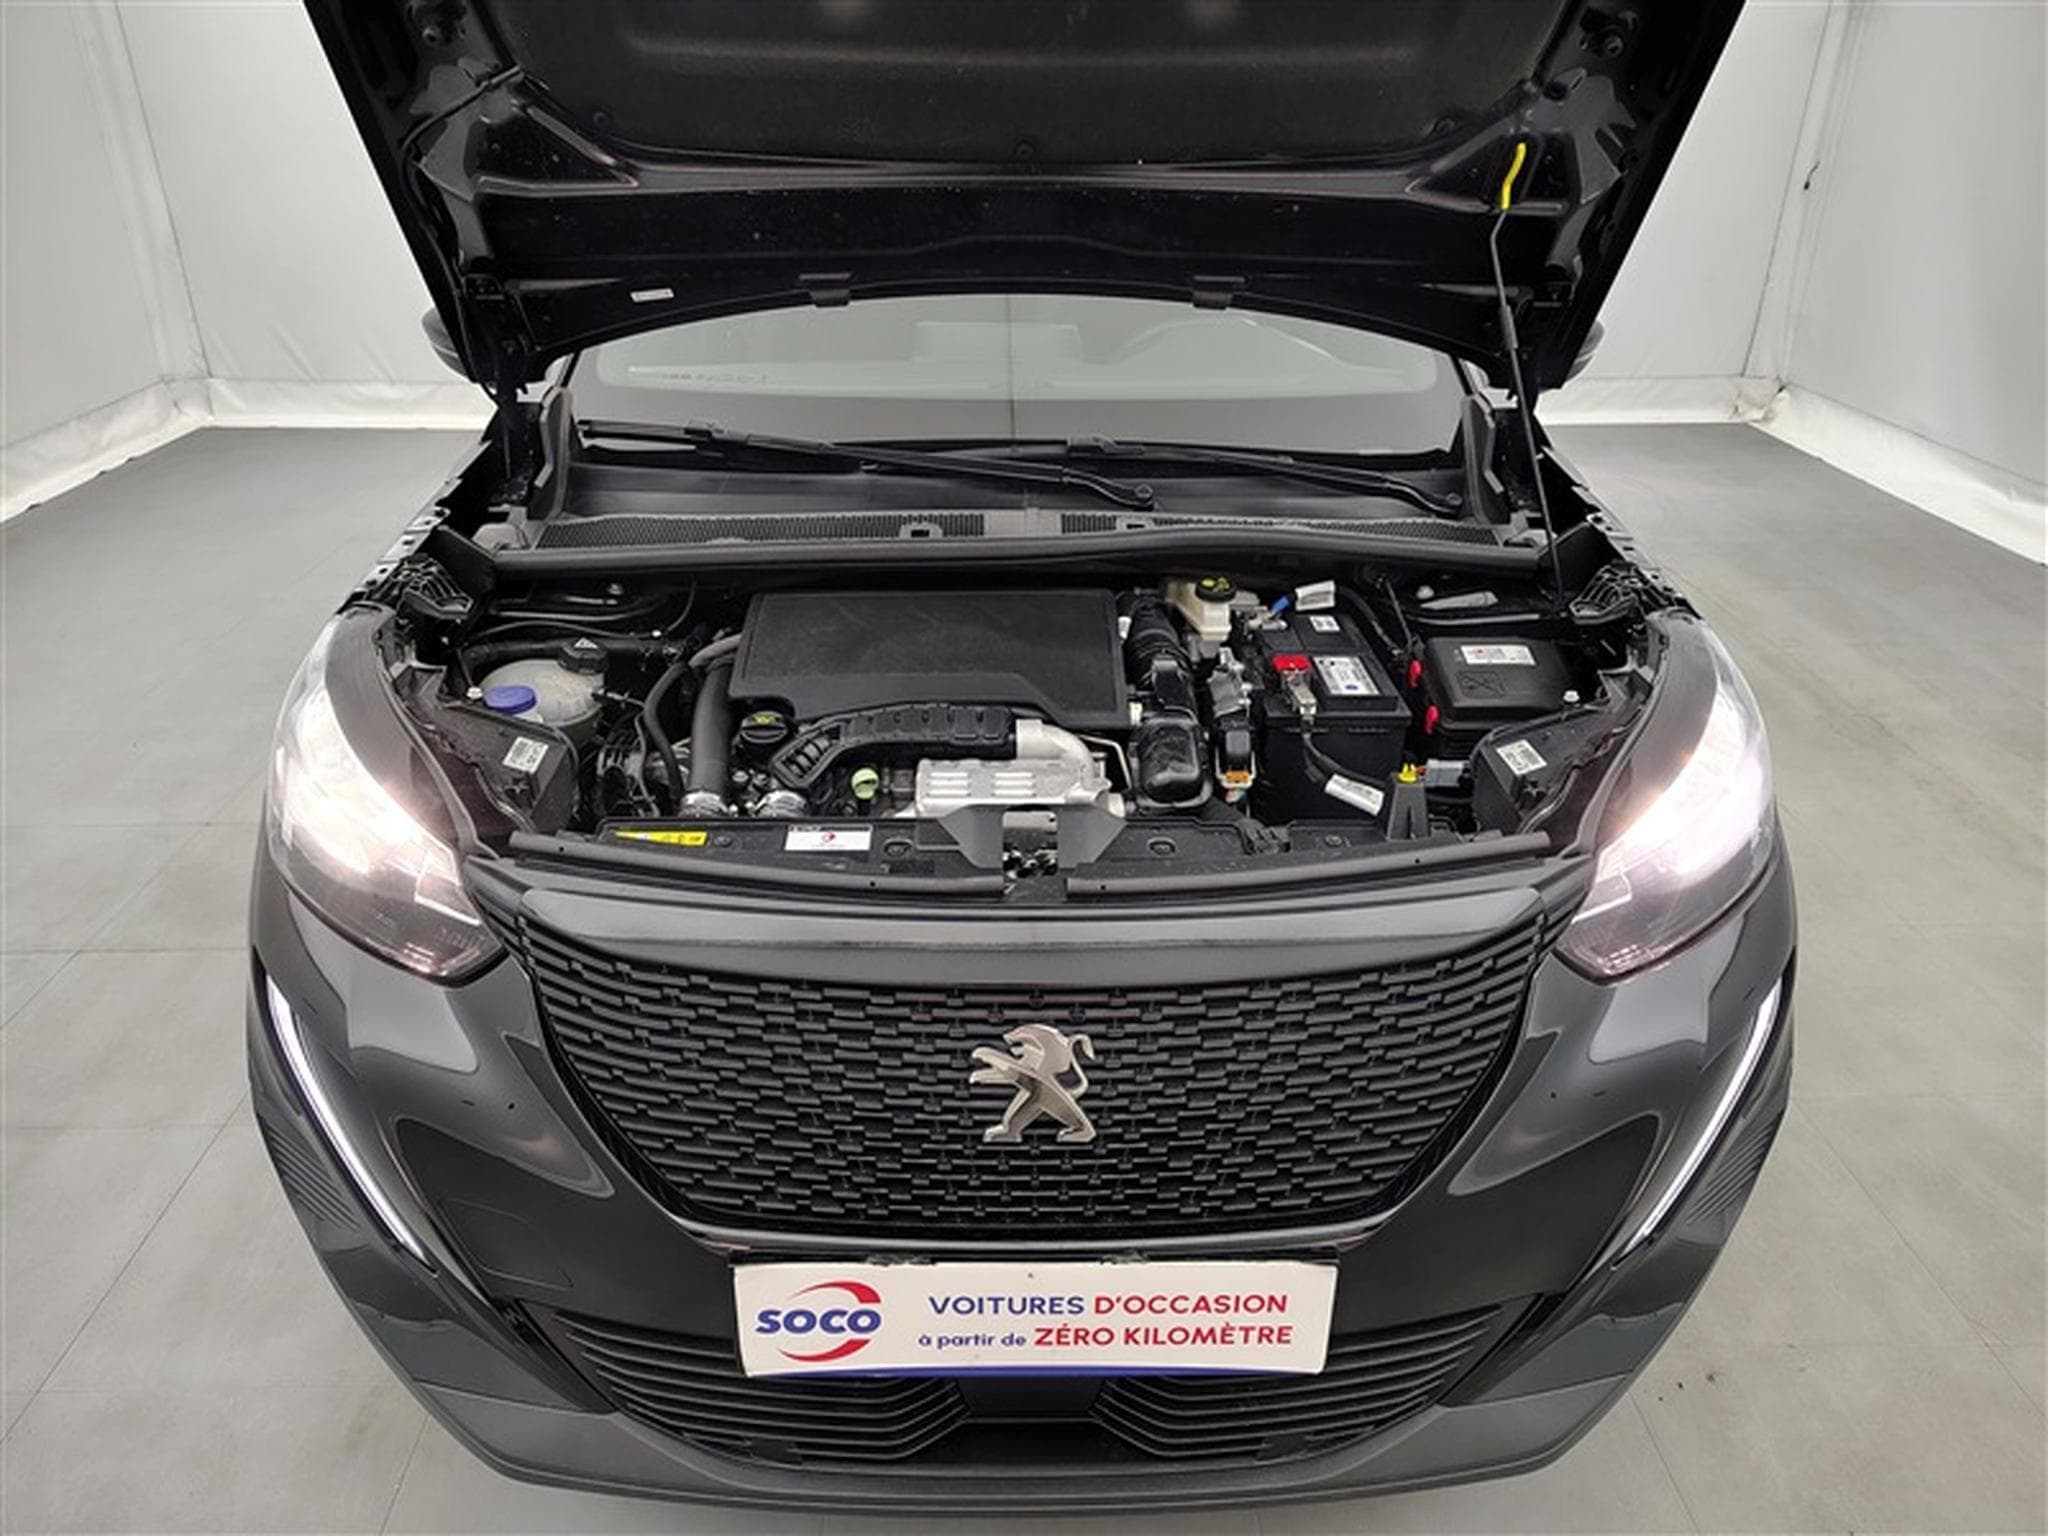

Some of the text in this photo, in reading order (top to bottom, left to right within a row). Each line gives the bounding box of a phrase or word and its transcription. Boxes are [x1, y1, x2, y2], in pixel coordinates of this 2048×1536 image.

[929, 1294, 1288, 1316] VOITURES D'OCCASION
[755, 1308, 882, 1334] SOCO
[918, 1321, 1294, 1350] à partir de ZÉRO KILOMÈTRE
